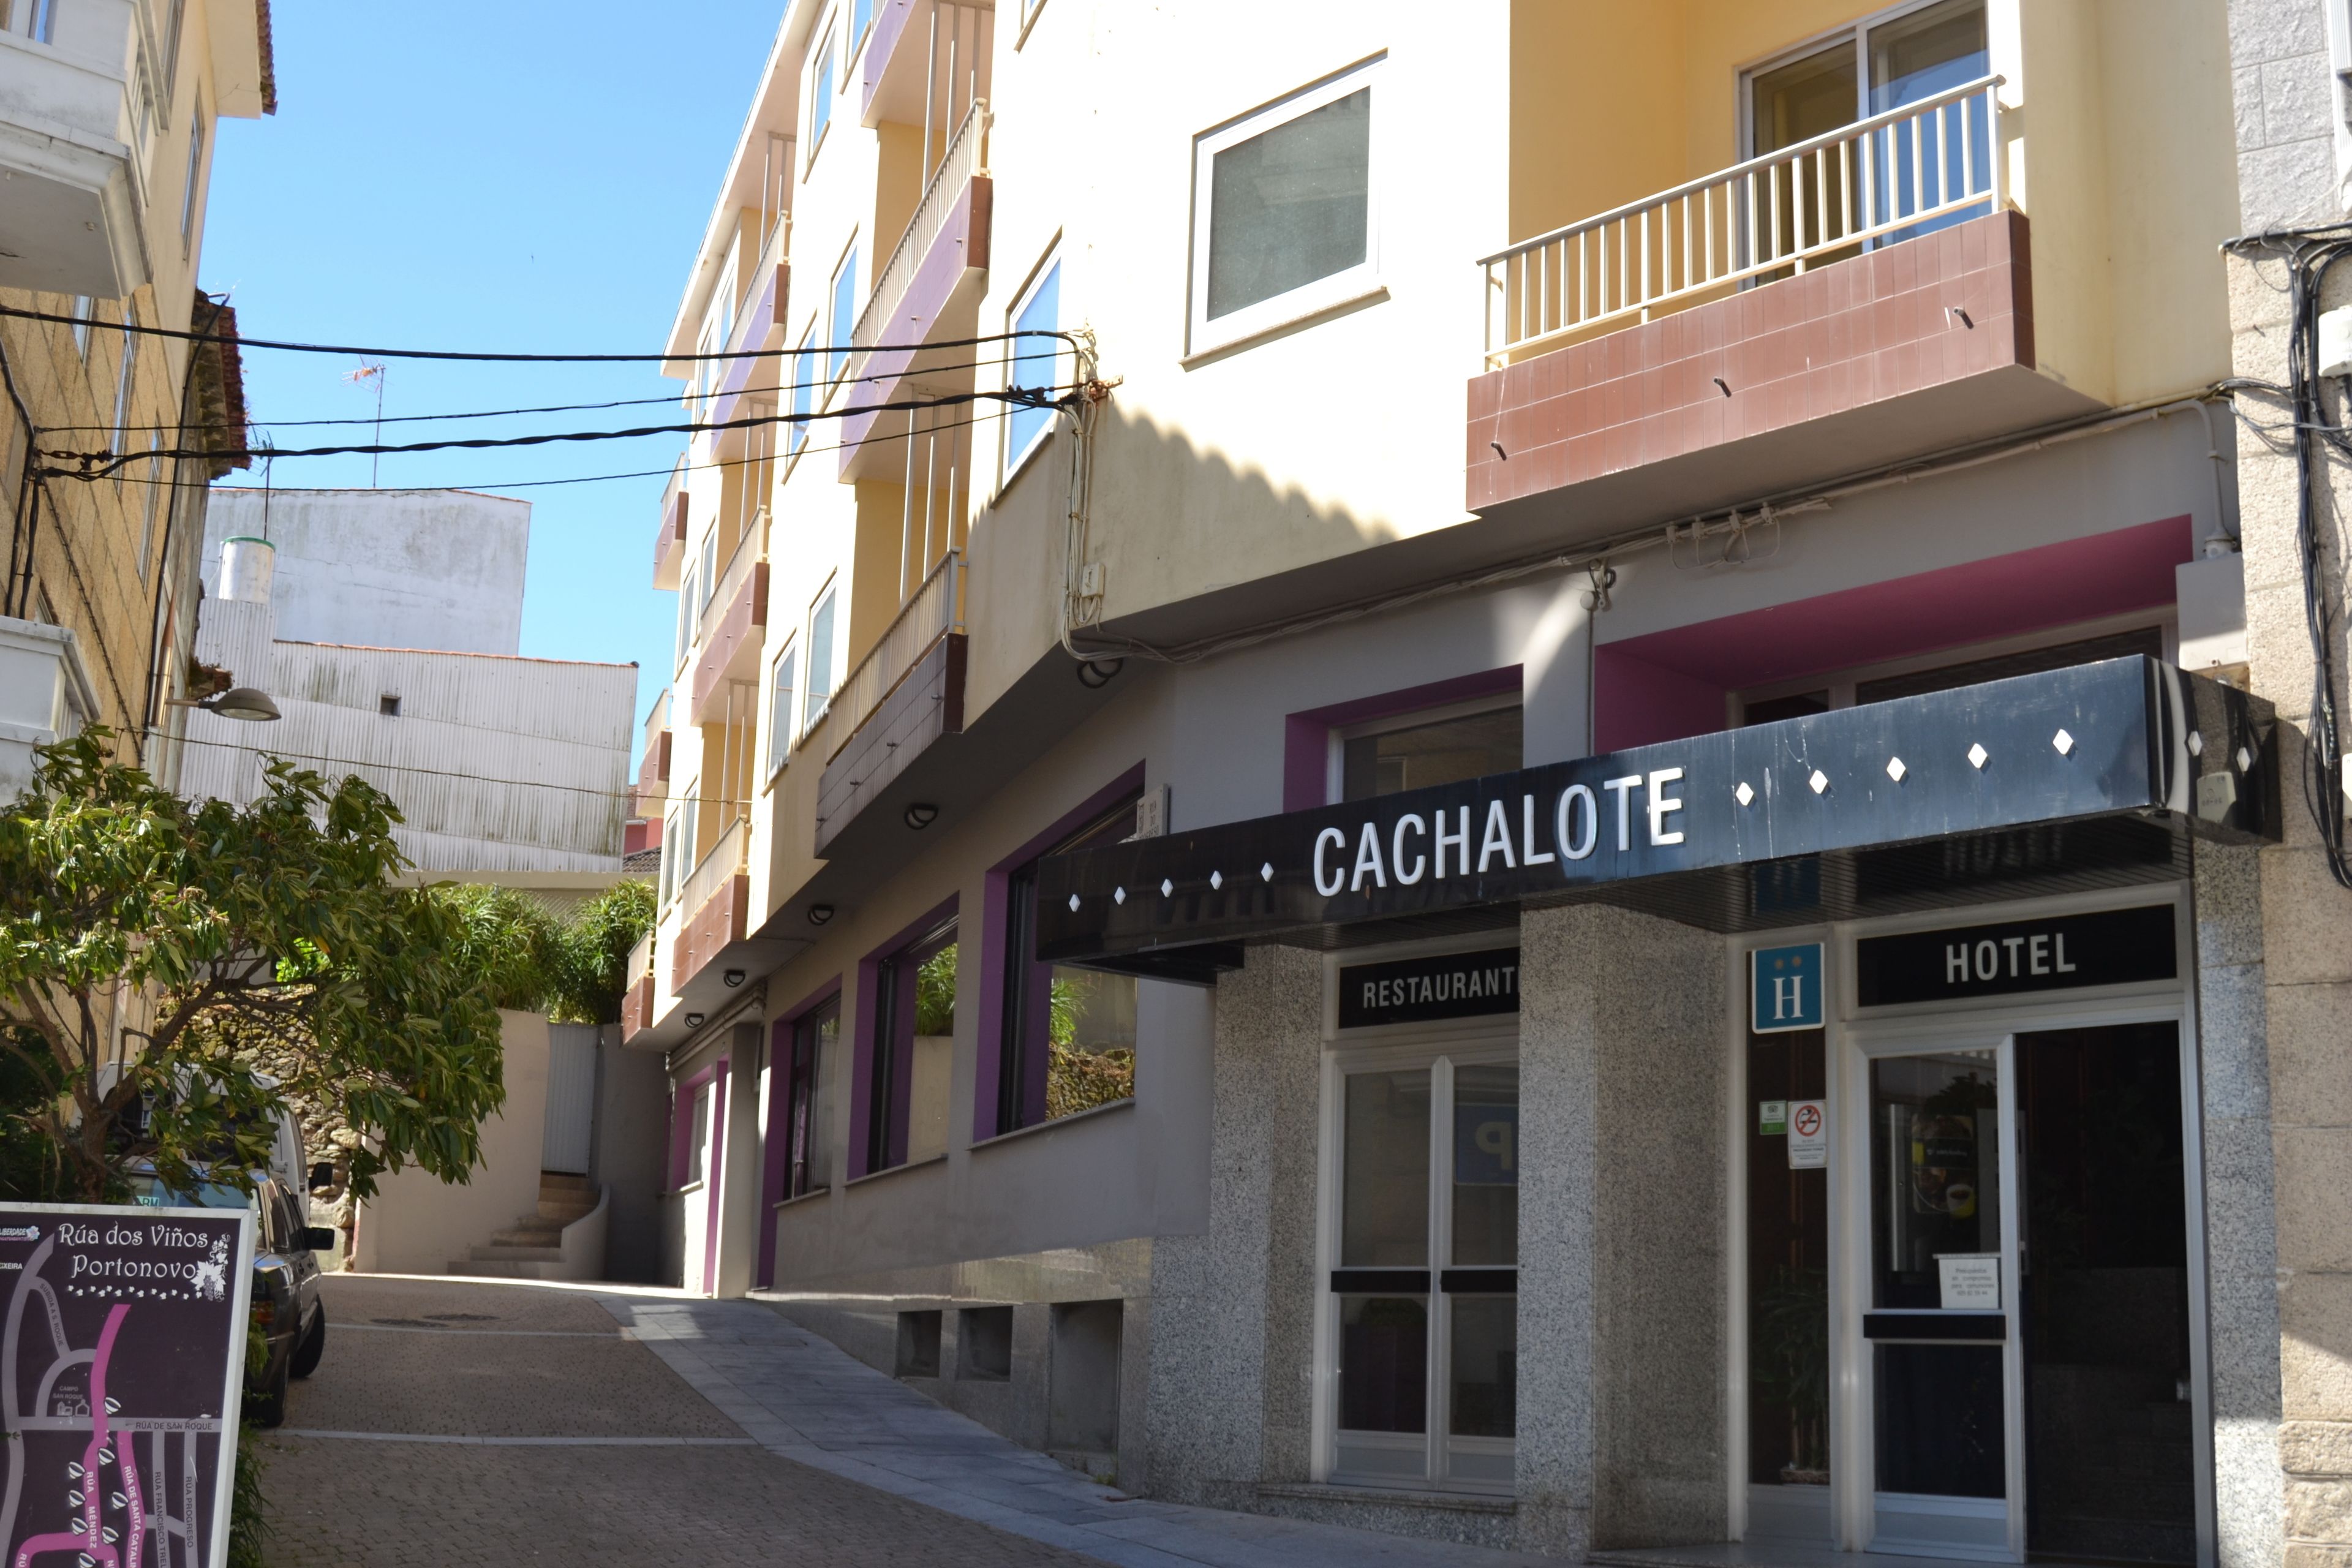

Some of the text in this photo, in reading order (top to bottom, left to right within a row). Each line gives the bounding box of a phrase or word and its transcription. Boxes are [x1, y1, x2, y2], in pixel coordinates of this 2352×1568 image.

[1314, 767, 1685, 897] CACHALOTE
[1947, 933, 2076, 984] HOTEL
[1363, 966, 1520, 1009] RESTAURANT
[1773, 975, 1803, 1020] H
[59, 1221, 208, 1248] Rúa dos Viños
[71, 1254, 196, 1279] Portonovo
[54, 1323, 64, 1347] ROQUE
[87, 1471, 96, 1493] RÚA
[124, 1466, 134, 1485] RÚA
[129, 1486, 137, 1499] DE
[131, 1500, 141, 1531] SANTA
[156, 1493, 165, 1544] FRANCISCO
